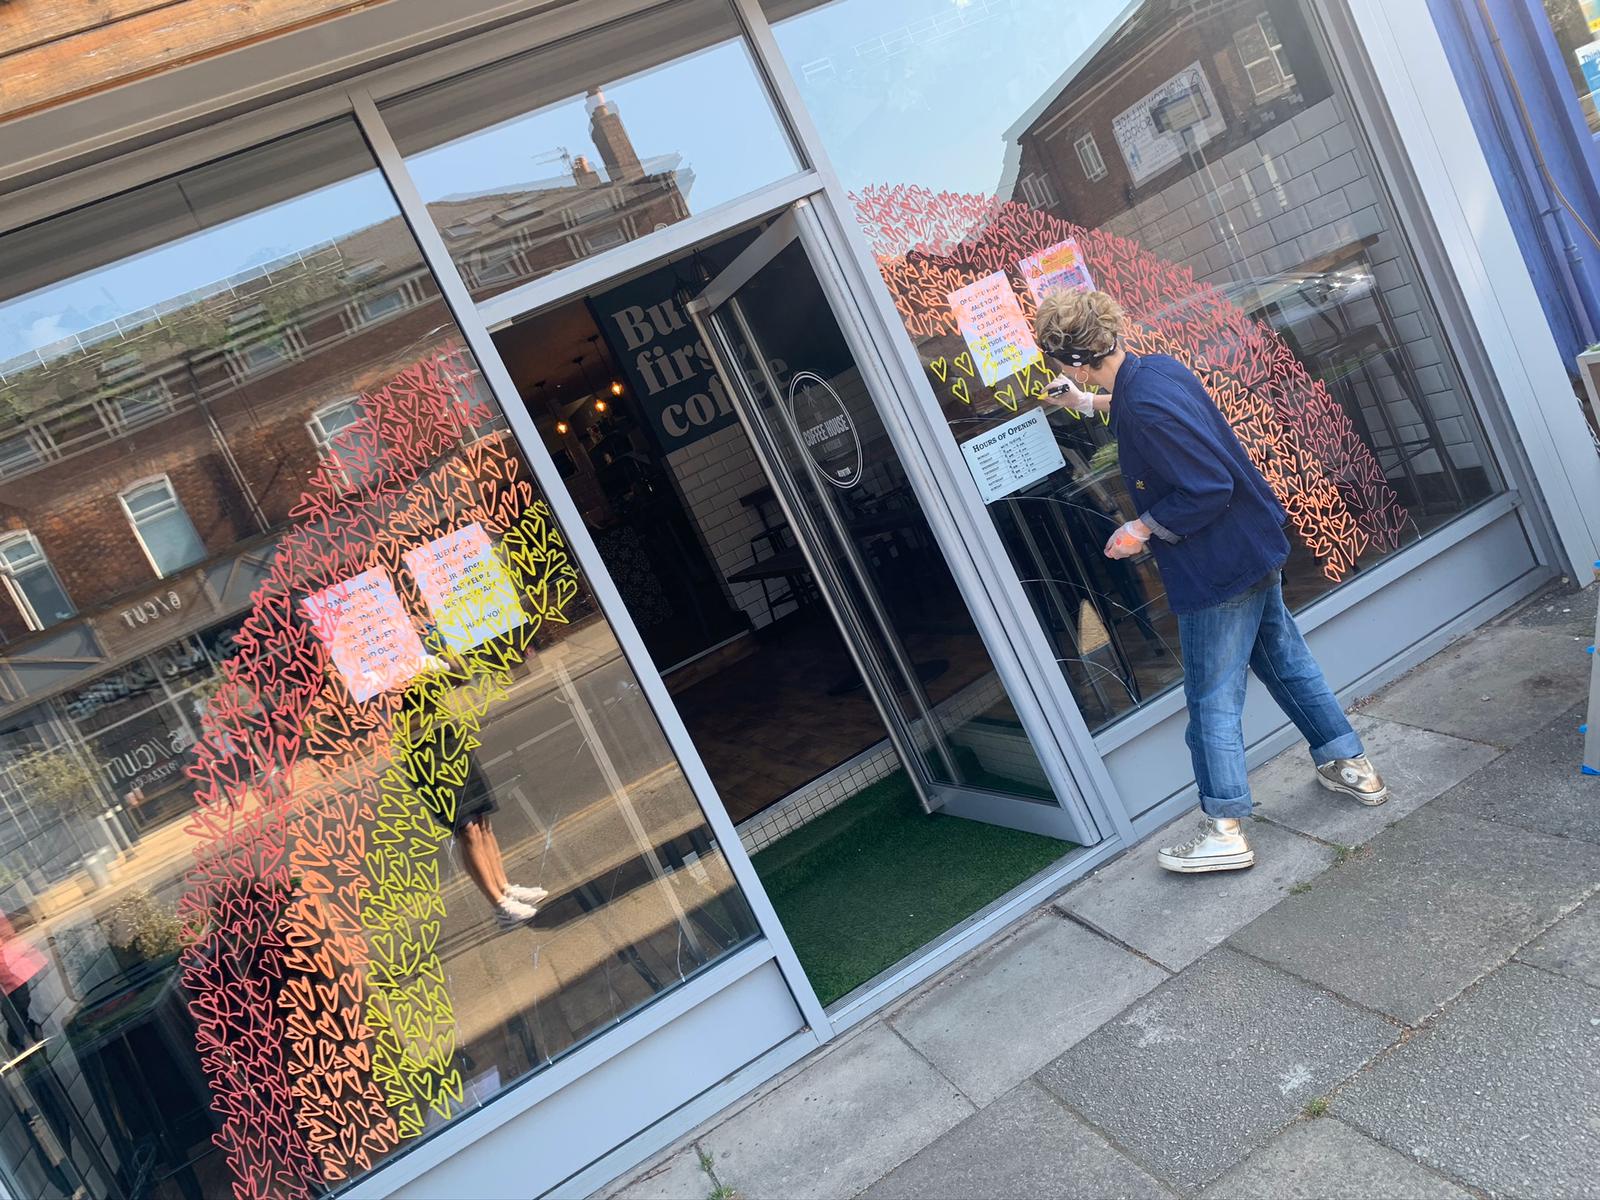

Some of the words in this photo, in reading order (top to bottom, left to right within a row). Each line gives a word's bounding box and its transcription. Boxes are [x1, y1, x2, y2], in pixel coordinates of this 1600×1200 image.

[611, 298, 692, 351] Bu
[636, 337, 718, 396] firs
[661, 358, 792, 437] cofee
[803, 423, 829, 447] COFFEE
[823, 414, 850, 438] HOUSE
[972, 437, 997, 453] HOURS
[998, 431, 1007, 441] OF
[1007, 417, 1038, 436] OPENING
